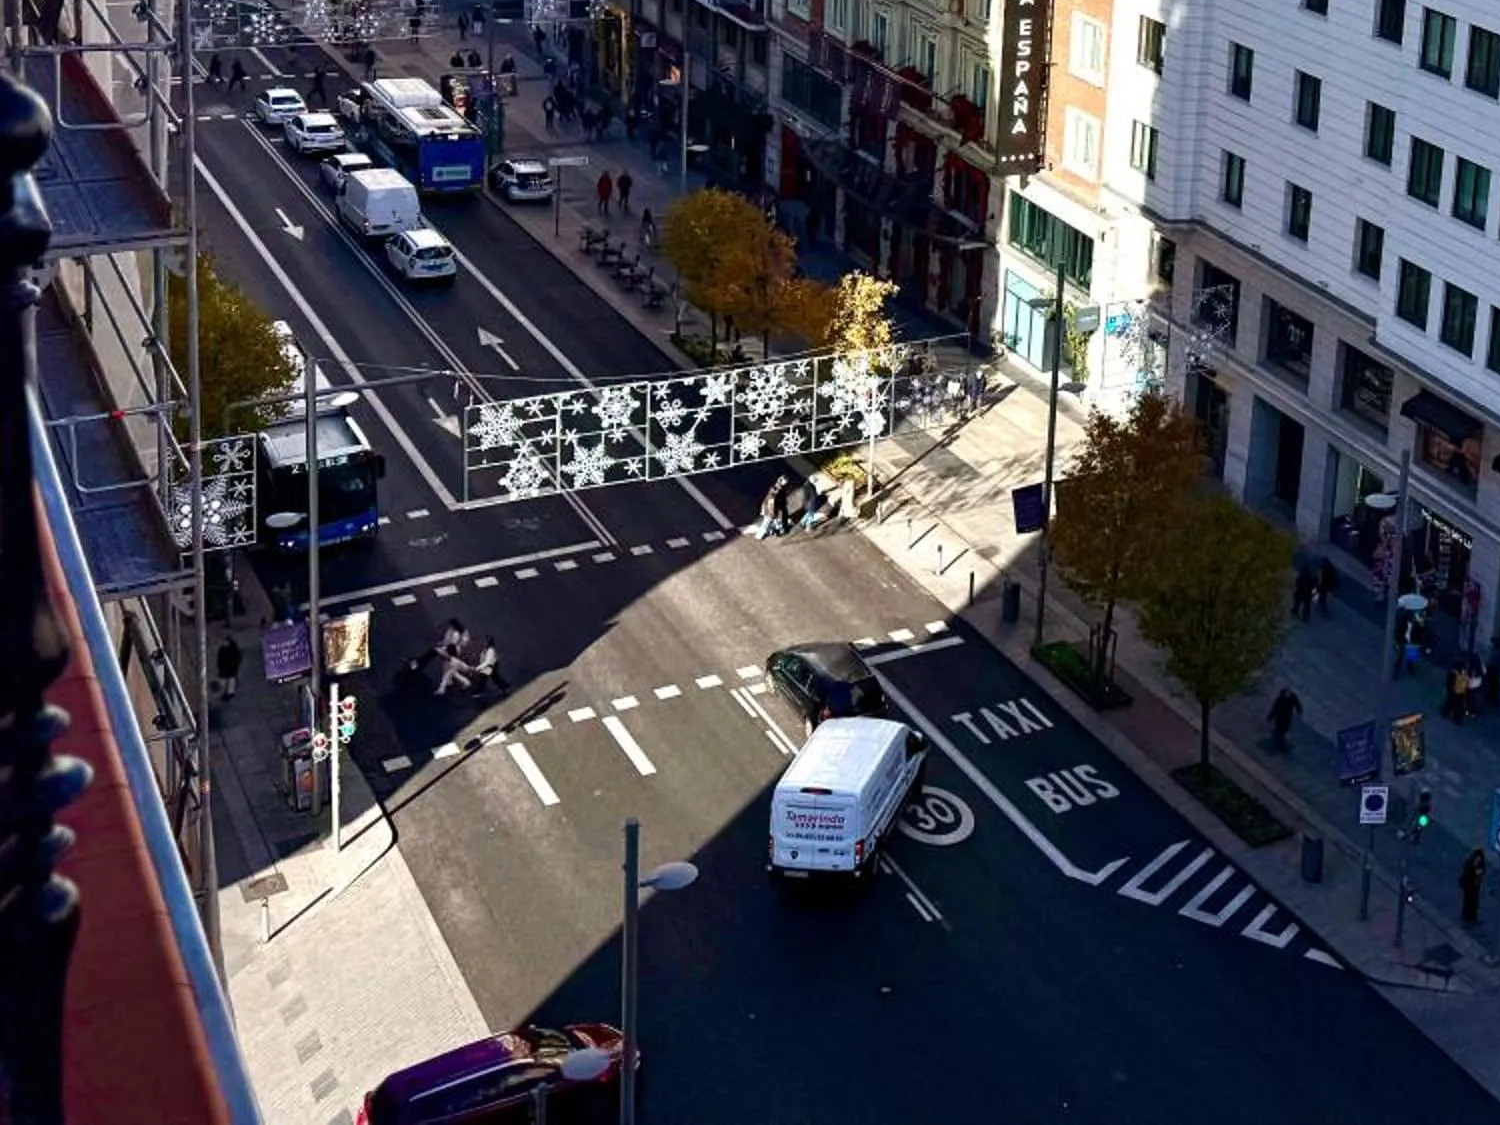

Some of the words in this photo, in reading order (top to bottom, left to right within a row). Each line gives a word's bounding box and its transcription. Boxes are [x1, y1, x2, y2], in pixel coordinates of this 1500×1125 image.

[1012, 19, 1032, 135] ESPAÑA
[952, 699, 1054, 744] TAXI
[1025, 764, 1120, 814] BUS
[906, 797, 955, 831] 30
